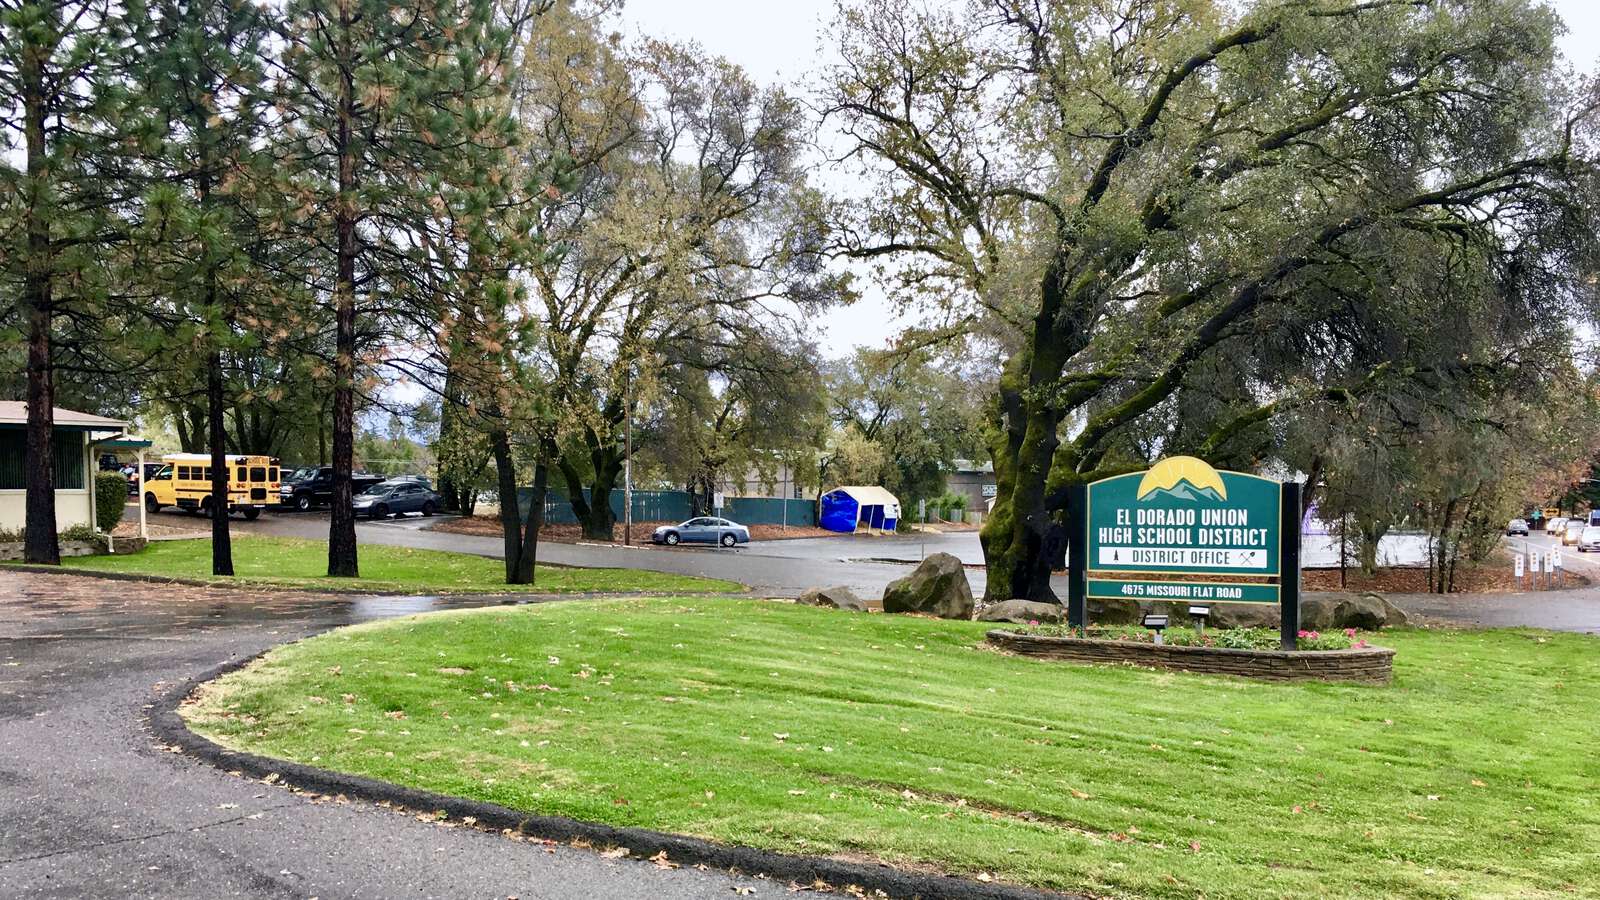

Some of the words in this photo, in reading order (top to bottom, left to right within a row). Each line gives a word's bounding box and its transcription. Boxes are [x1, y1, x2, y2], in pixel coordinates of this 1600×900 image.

[1116, 509, 1131, 525] EL
[1137, 509, 1195, 526] DORADO
[1201, 509, 1248, 526] UNION
[1099, 528, 1132, 544] HIGH
[1137, 528, 1192, 545] SCHOOL
[1198, 528, 1267, 546] DISTRICT
[1132, 550, 1185, 564] DISTRICT
[1190, 551, 1230, 565] OFFICE
[1121, 584, 1144, 596] 4675
[1146, 585, 1191, 597] MISSOURI
[1193, 586, 1213, 598] FLAT
[1216, 587, 1242, 598] ROAD
